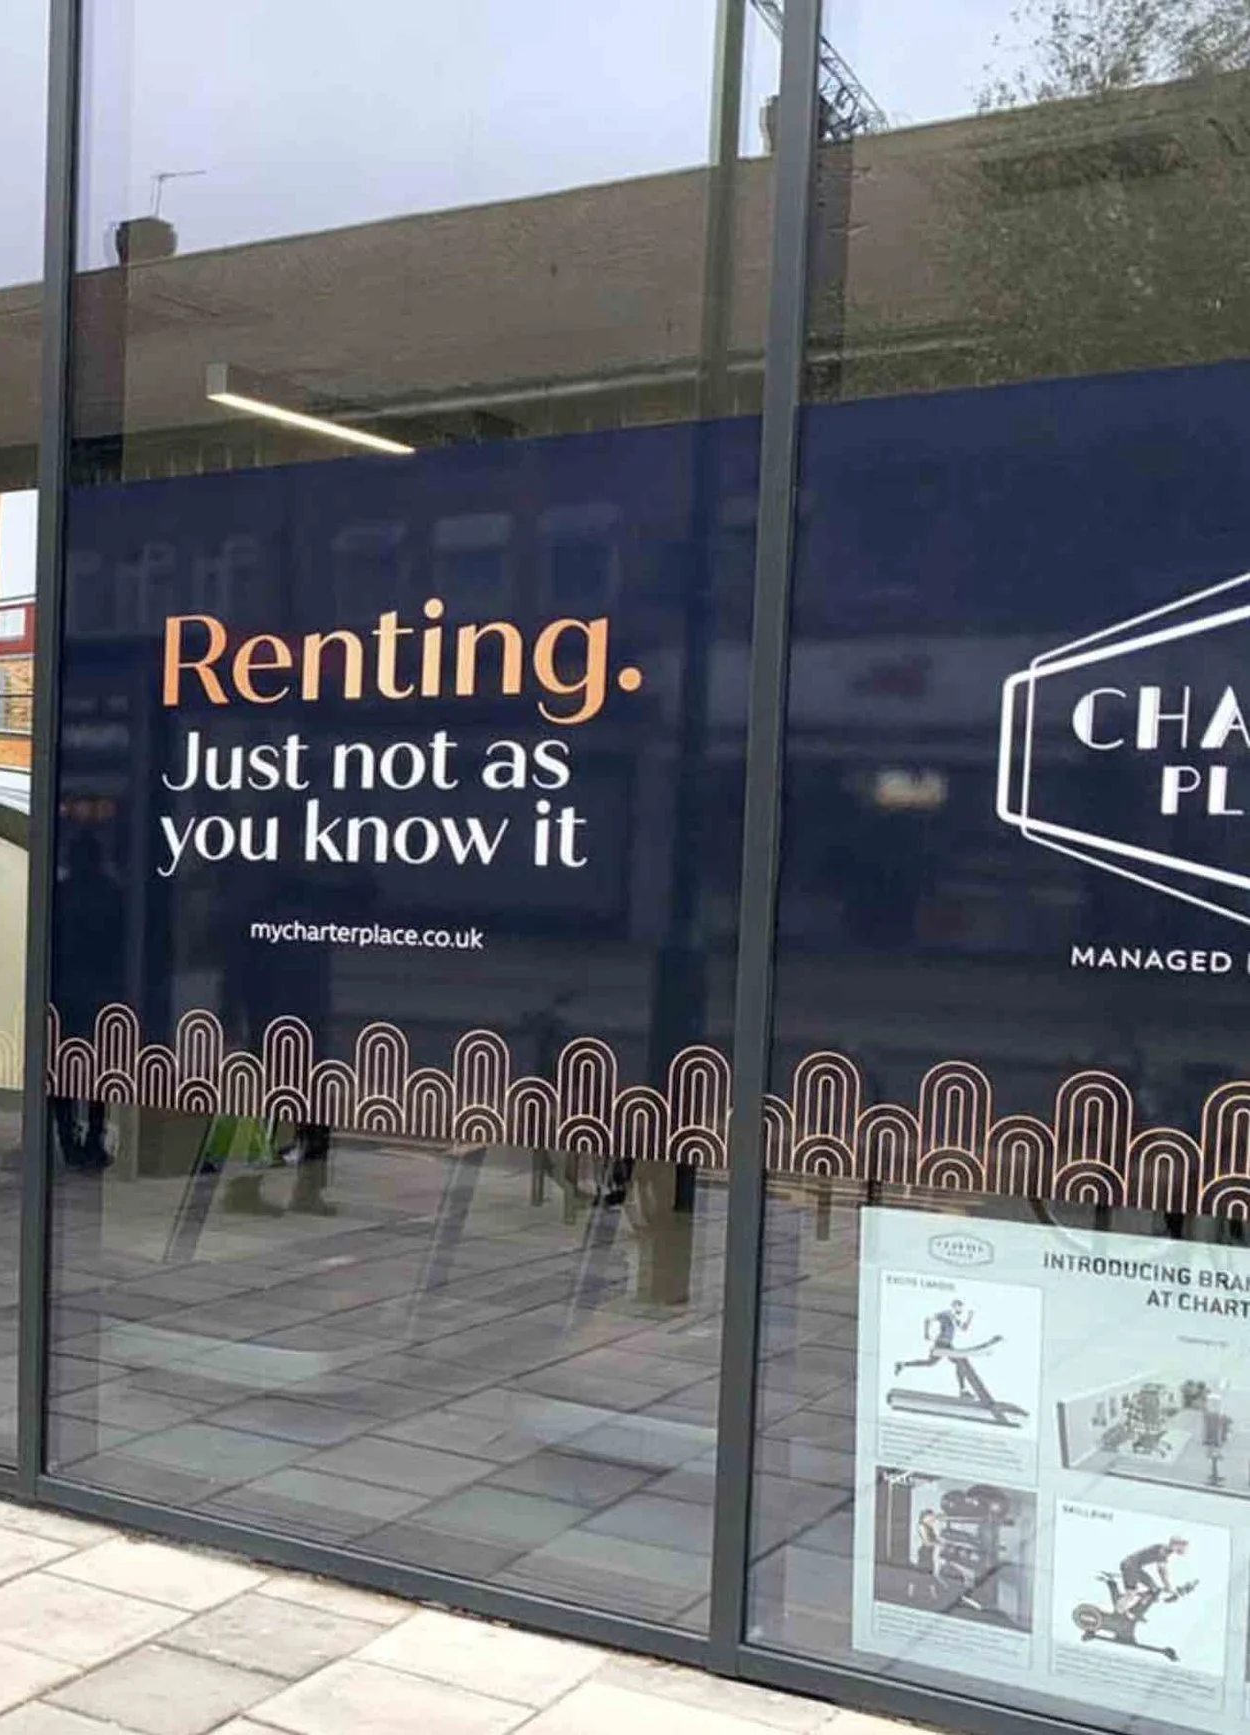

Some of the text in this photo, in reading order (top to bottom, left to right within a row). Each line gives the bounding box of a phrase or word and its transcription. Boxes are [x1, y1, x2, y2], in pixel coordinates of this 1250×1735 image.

[163, 598, 642, 725] Renting.
[1072, 685, 1250, 750] CHA
[162, 730, 570, 791] Just not as
[1161, 765, 1244, 816] PL
[157, 799, 588, 877] you know it
[251, 919, 484, 949] mycharterplace.co.uk
[1071, 946, 1232, 973] MANAGED
[1043, 1251, 1191, 1286] INTRODUCING
[1146, 1289, 1172, 1309] AT
